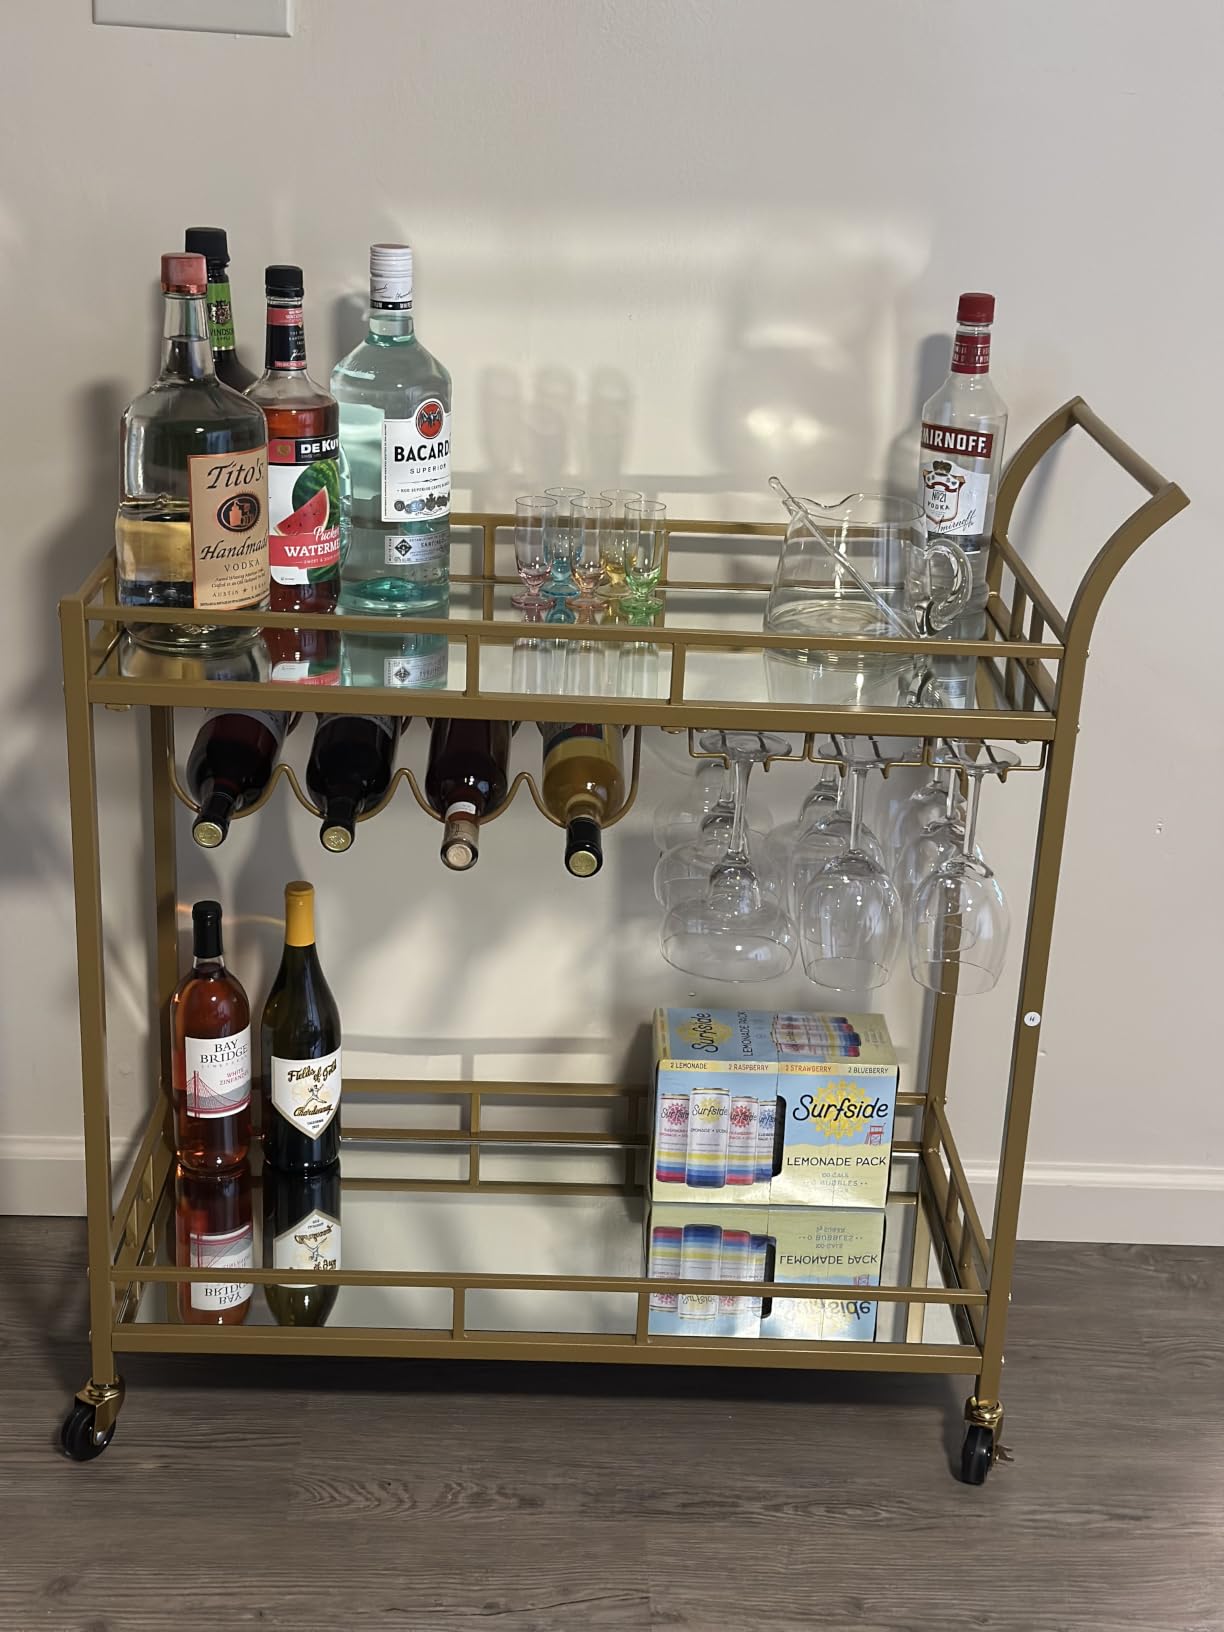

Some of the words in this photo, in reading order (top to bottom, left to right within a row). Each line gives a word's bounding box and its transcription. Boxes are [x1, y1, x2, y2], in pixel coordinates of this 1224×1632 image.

[922, 427, 986, 454] MIRNOFF
[394, 440, 450, 462] BACARD
[206, 458, 264, 490] Tito's
[410, 463, 447, 475] SUPERIOR
[927, 500, 950, 511] VODKA
[199, 529, 268, 560] Handmad
[284, 538, 340, 557] WATERME
[224, 559, 260, 572] VODKA
[691, 1012, 719, 1053] Surfside
[739, 1025, 754, 1057] LEMONADE
[200, 1044, 248, 1063] BRIDGE
[215, 1039, 238, 1053] BAY
[226, 1068, 244, 1078] WHITE
[692, 1104, 728, 1117] Surfside
[792, 1094, 889, 1121] Surfside
[786, 1157, 852, 1166] LEMONADE
[856, 1157, 887, 1166] PACK
